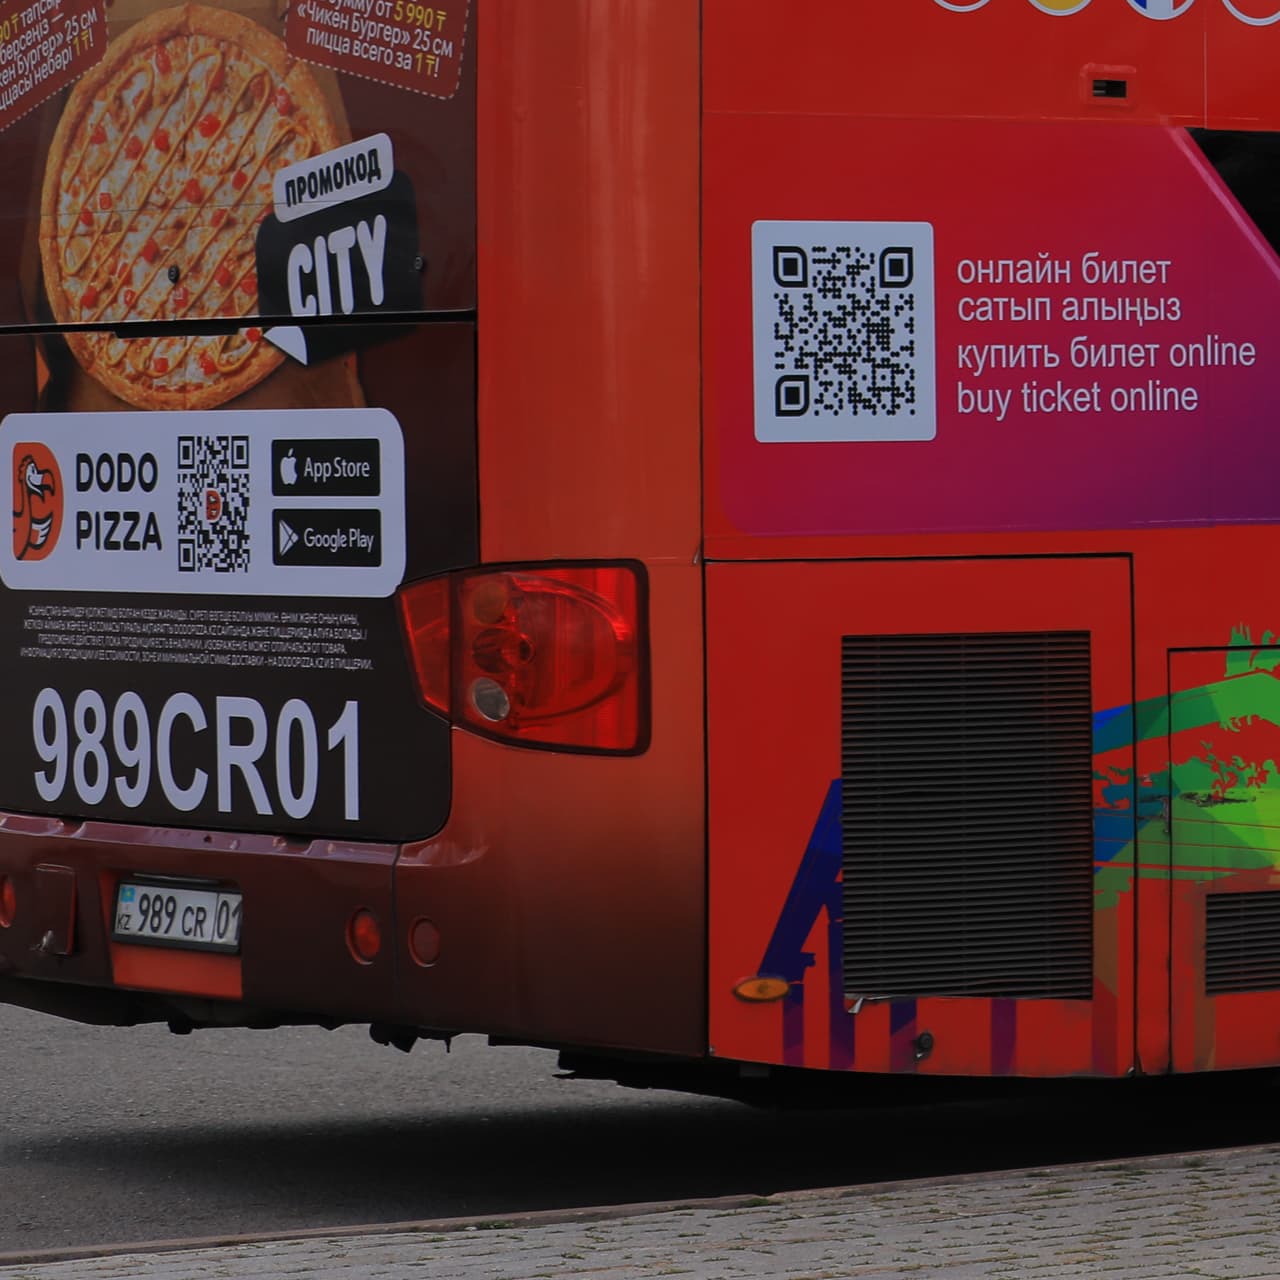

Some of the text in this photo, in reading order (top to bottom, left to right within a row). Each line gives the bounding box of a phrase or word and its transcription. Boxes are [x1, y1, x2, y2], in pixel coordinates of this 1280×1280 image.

[297, 0, 453, 58] «Чикен Бургер» 25 см
[376, 1, 393, 18] от
[0, 17, 49, 66] берсеңіз
[17, 31, 64, 76] бургер»
[64, 15, 80, 43] 25
[80, 7, 98, 30] см
[306, 27, 350, 53] пицца
[352, 40, 393, 66] всего
[394, 53, 413, 71] за
[285, 148, 381, 207] ПРОМОКОД
[287, 214, 387, 317] CITY
[957, 252, 1171, 284] онлайн билет
[957, 295, 1182, 328] сатып алыңыз
[957, 335, 1257, 377] купить билет online
[957, 380, 1199, 421] buy ticket online
[75, 452, 159, 492] DODO
[304, 455, 371, 483] App Store
[76, 511, 162, 551] PIZZA
[303, 528, 375, 557] Google Play
[33, 687, 360, 821] 989CR01
[116, 913, 131, 931] KZ
[138, 893, 177, 935] 989
[181, 906, 207, 937] CR
